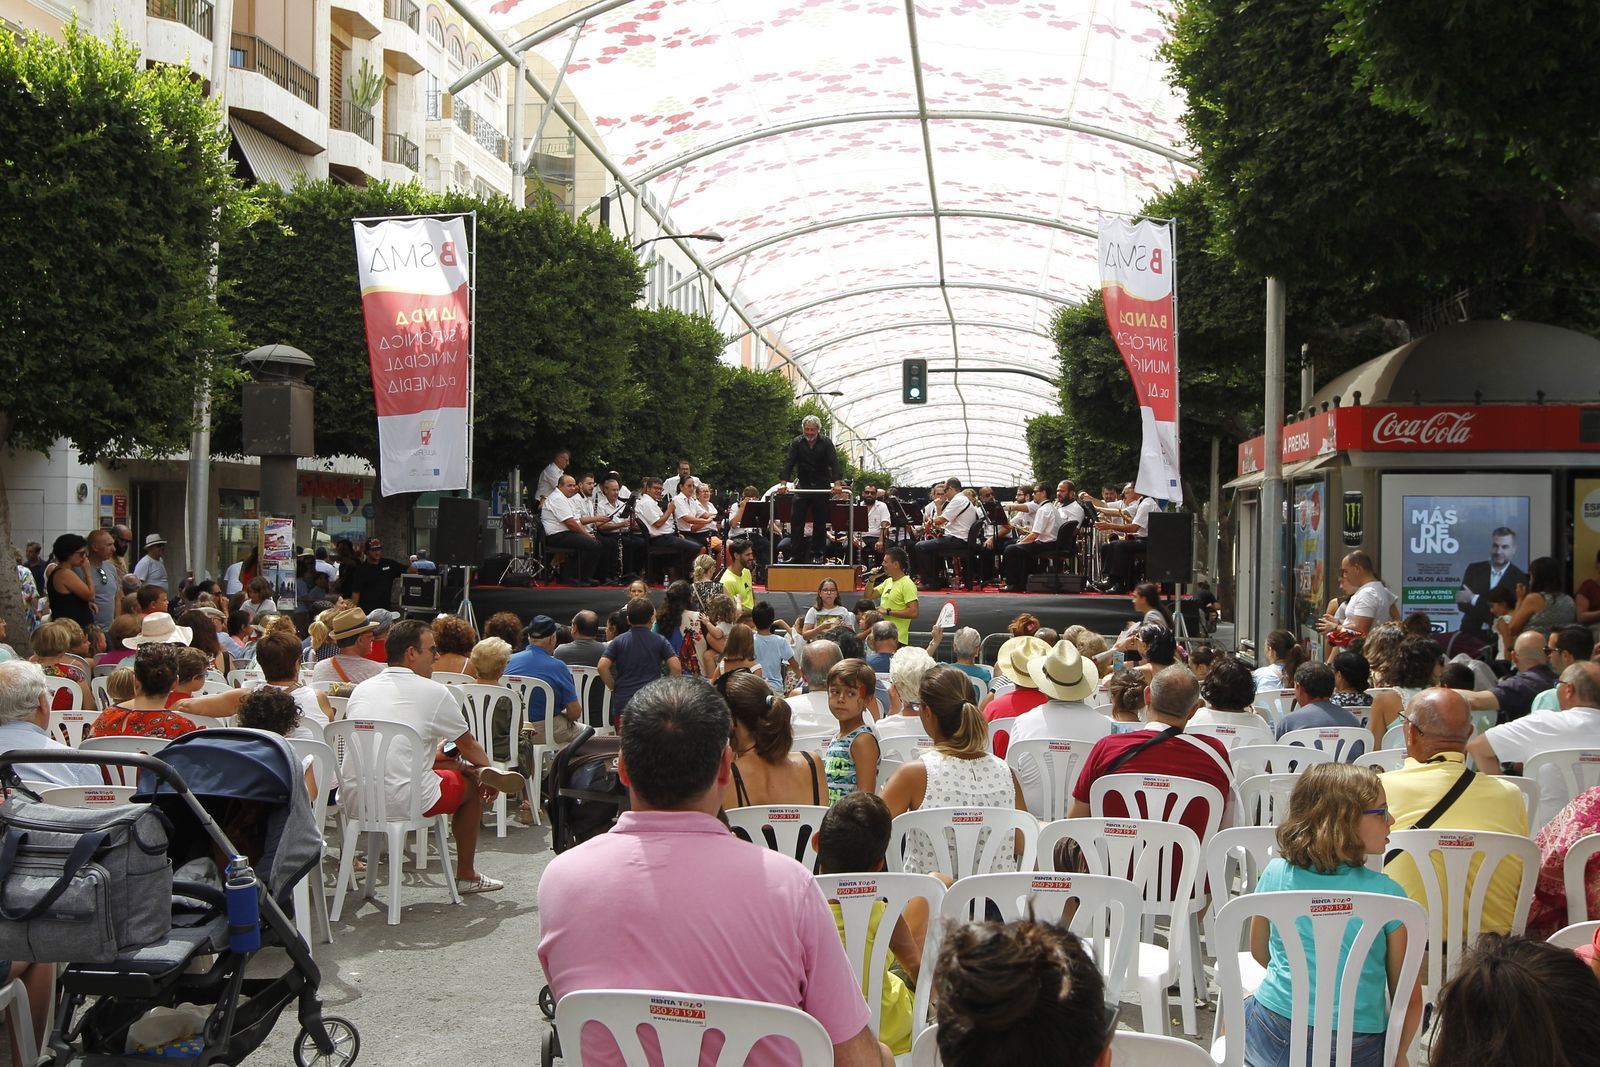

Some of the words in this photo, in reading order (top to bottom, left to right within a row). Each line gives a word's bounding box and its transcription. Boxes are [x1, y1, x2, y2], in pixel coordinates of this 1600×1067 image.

[1372, 411, 1477, 444] Coca-Cola
[1287, 431, 1310, 453] PRENSA
[1411, 505, 1458, 525] MÁS
[1420, 523, 1450, 539] DE
[1410, 537, 1460, 554] UNO
[651, 1005, 667, 1014] 950
[668, 1008, 680, 1016] 29
[682, 1009, 693, 1017] 19
[694, 1010, 705, 1018] 71
[677, 1000, 703, 1008] TODO
